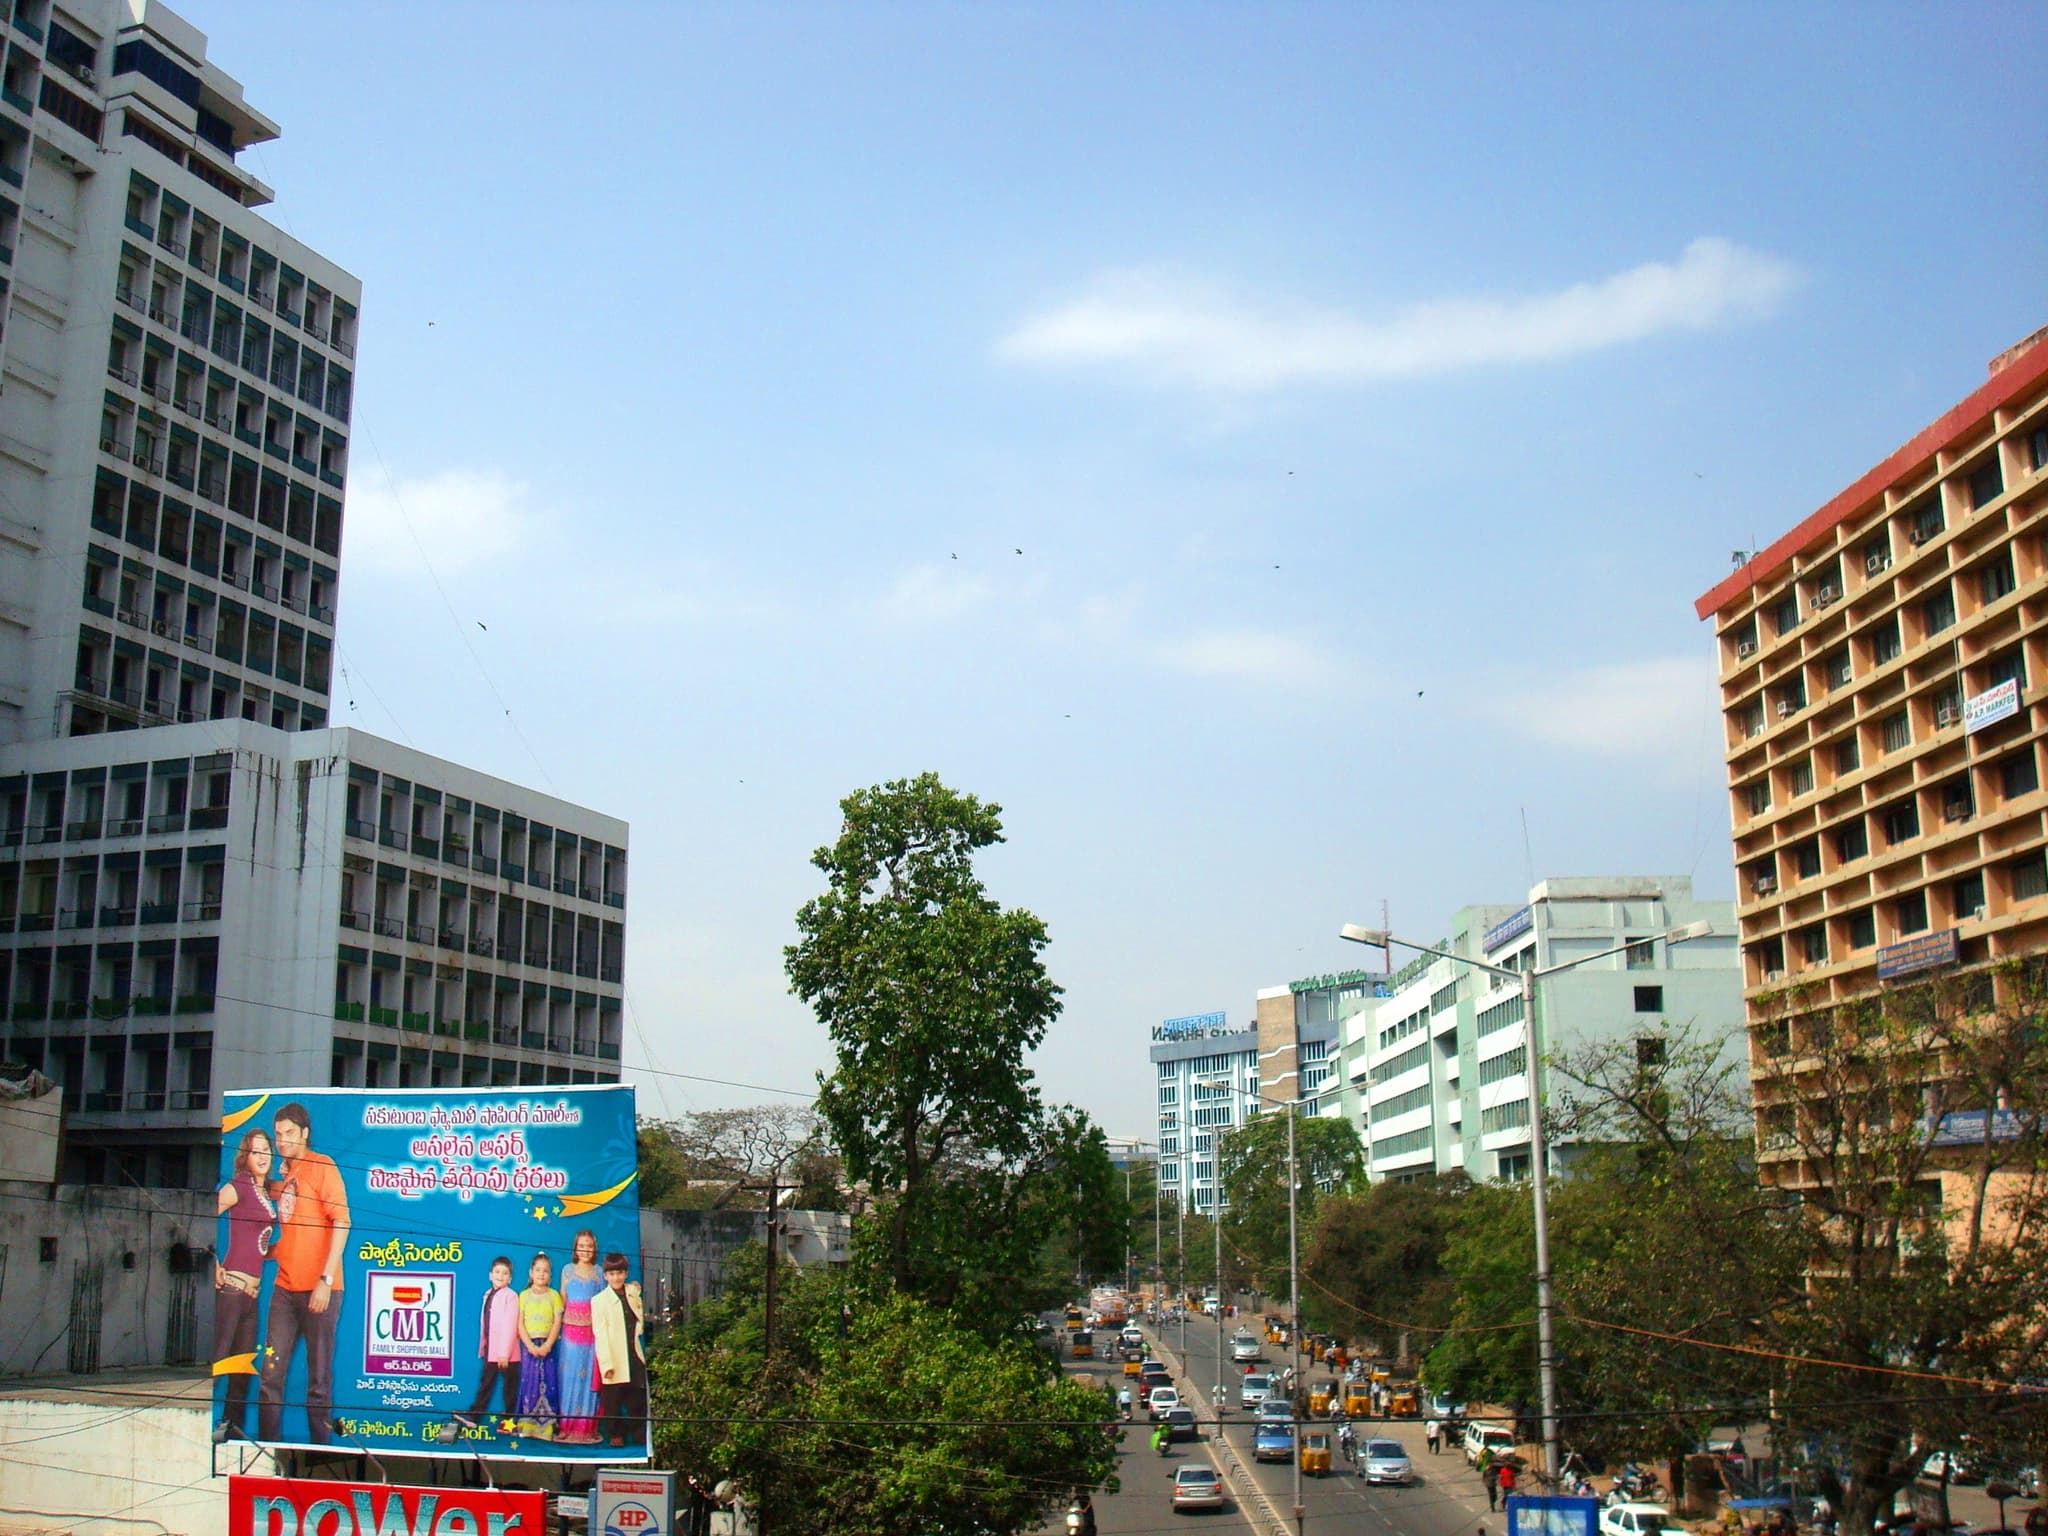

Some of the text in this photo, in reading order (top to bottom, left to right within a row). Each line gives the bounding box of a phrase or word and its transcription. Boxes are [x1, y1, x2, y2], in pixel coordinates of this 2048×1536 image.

[366, 1106, 426, 1124] సకుటుంబ
[480, 1103, 528, 1125] షాపింగ్
[412, 1131, 528, 1165] అసలైన ఆఫర్స్
[370, 1165, 566, 1200] నిజమైన తగ్గింపు ధరలు
[375, 1307, 443, 1342] CMR
[372, 1343, 446, 1355] FAMILY SHOPPING MALL
[618, 1509, 648, 1527] HP
